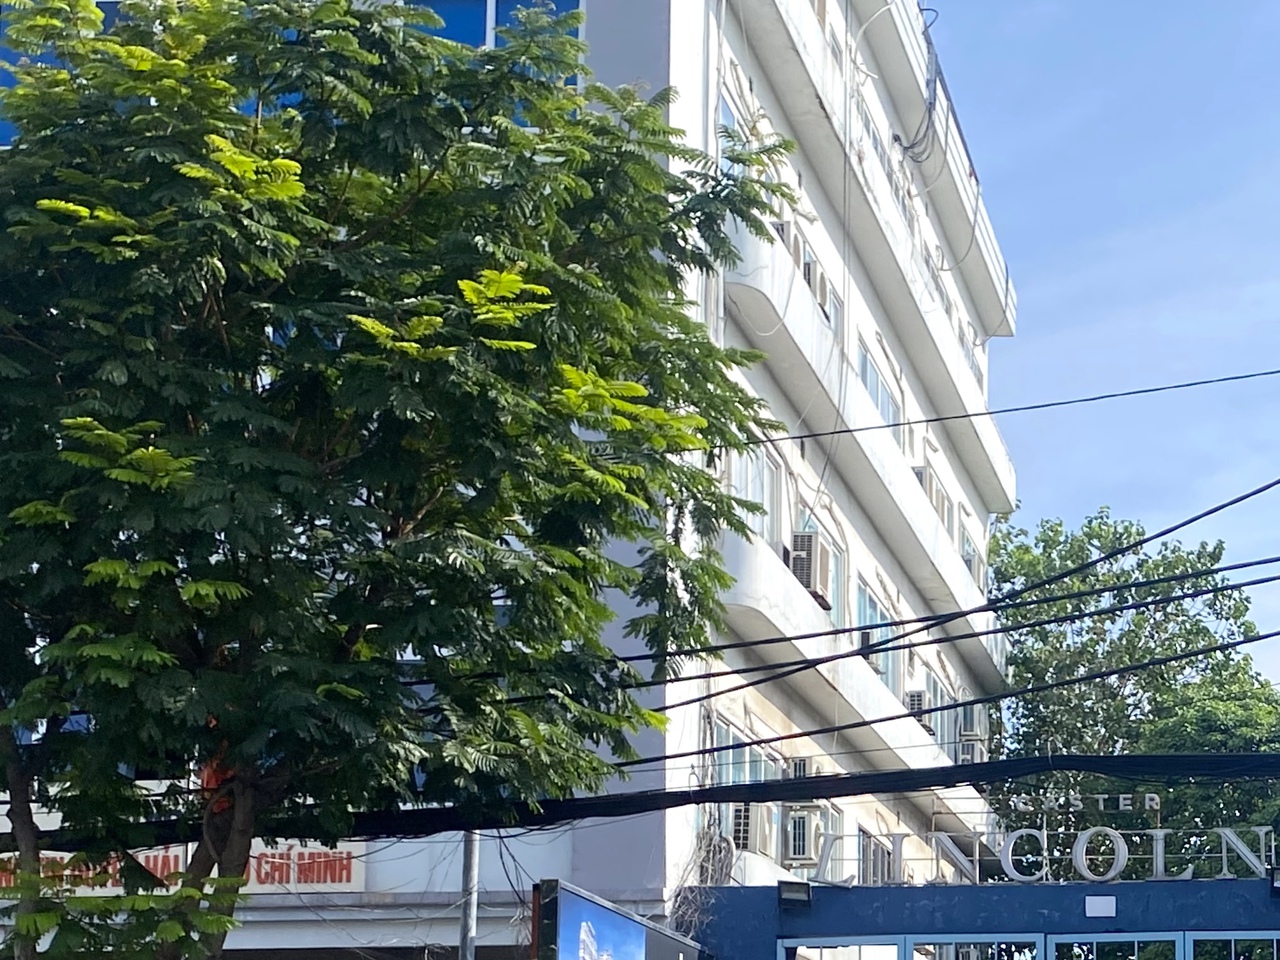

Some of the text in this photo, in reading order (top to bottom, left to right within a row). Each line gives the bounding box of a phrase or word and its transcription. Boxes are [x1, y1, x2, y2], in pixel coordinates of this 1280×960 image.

[256, 845, 292, 885] CHÍ
[296, 850, 353, 884] MINH
[807, 825, 1275, 888] LINCOLN
